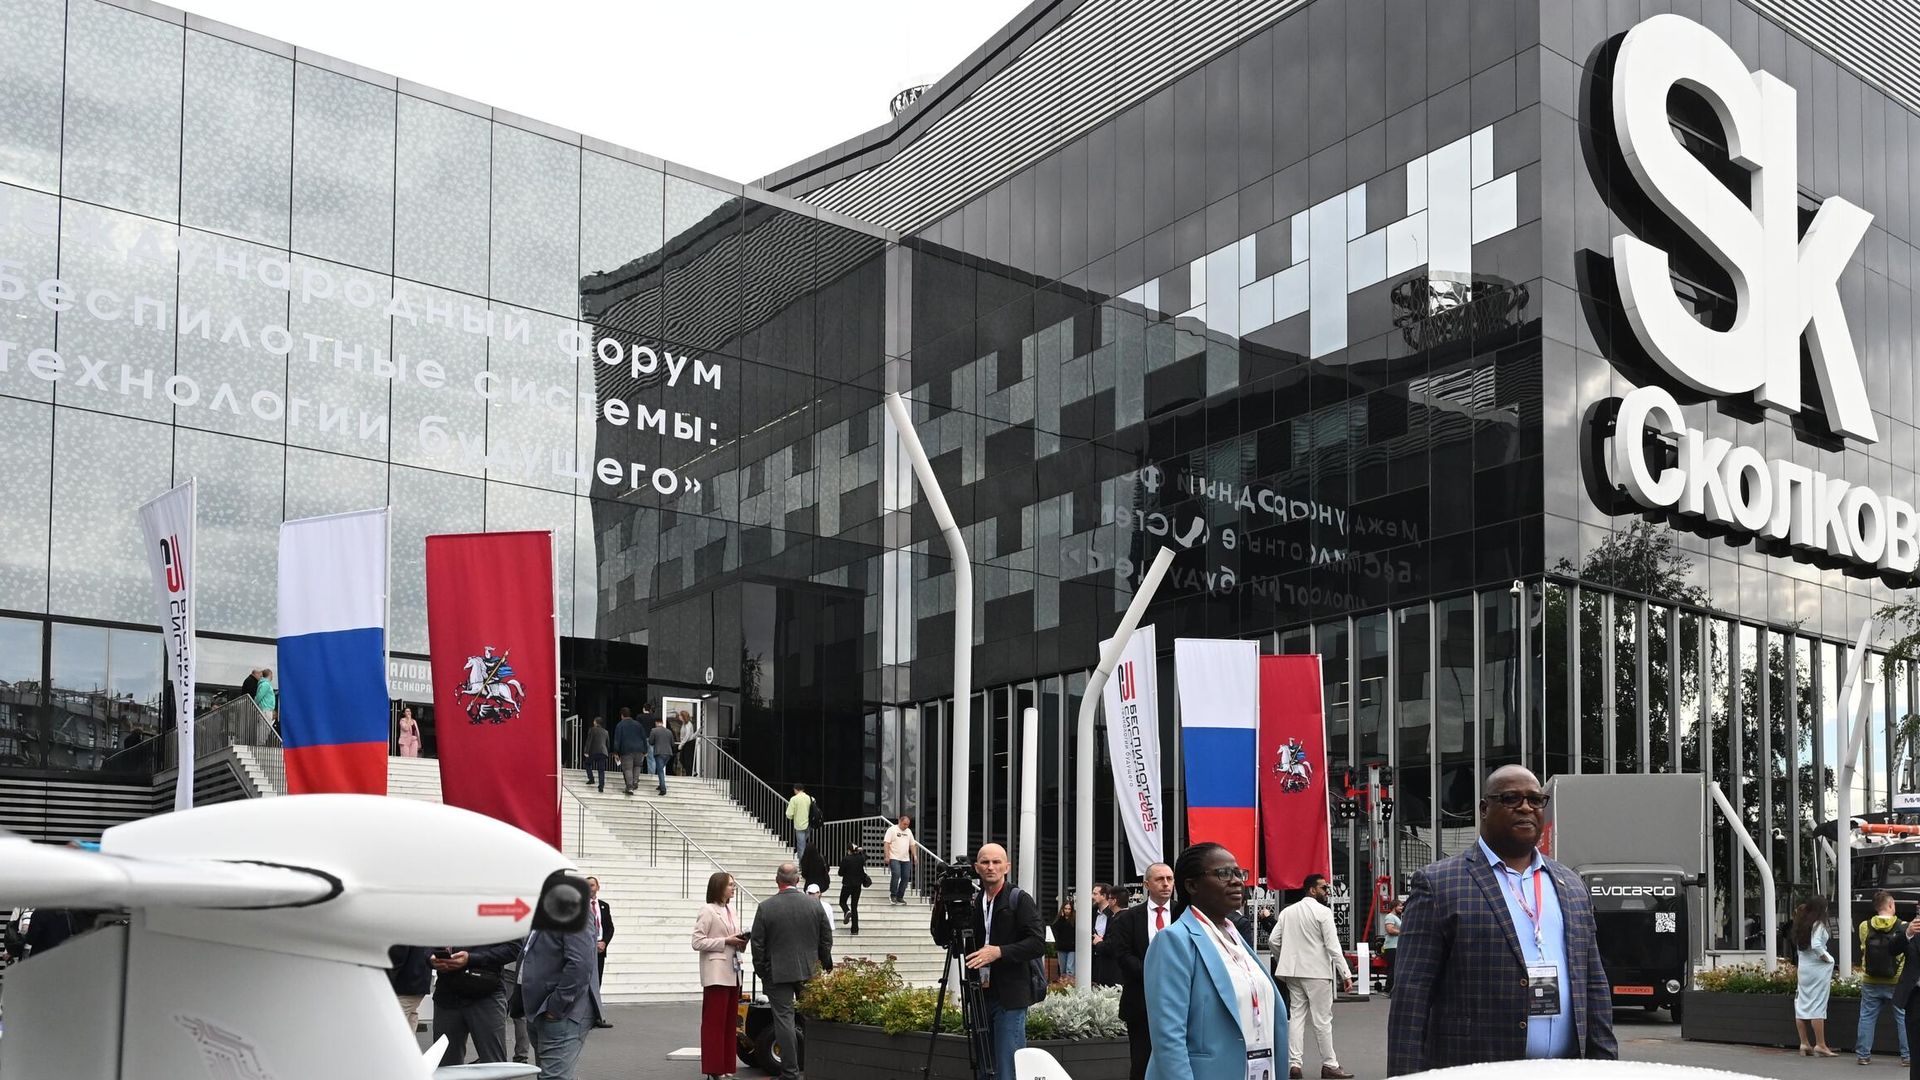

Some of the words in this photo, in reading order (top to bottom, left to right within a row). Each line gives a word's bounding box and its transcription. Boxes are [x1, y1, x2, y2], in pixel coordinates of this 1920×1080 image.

[1613, 12, 1880, 444] Sk
[0, 190, 530, 346] еждународный
[557, 320, 722, 390] форум
[0, 340, 389, 444] технологии
[418, 415, 701, 495] будущего»
[474, 370, 718, 446] системы:
[1138, 791, 1154, 833] 2025
[1591, 886, 1676, 896] EVOCARGO
